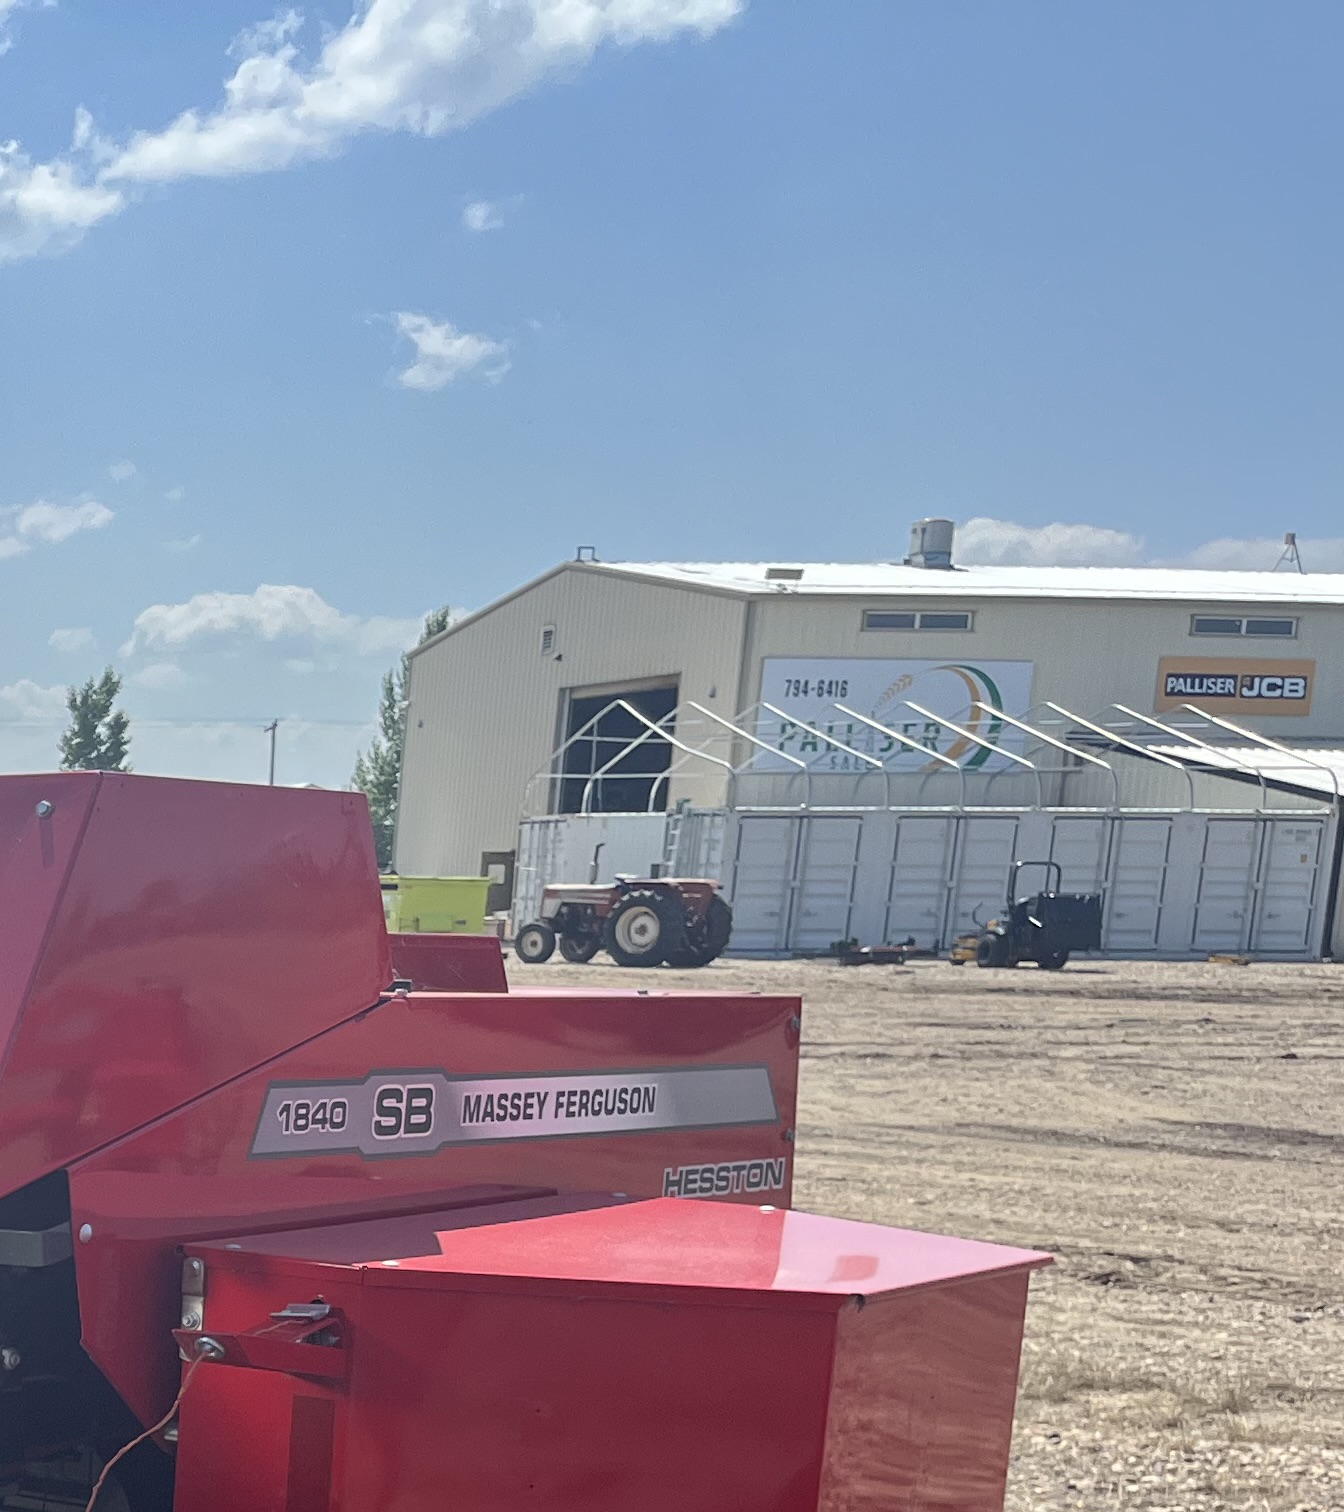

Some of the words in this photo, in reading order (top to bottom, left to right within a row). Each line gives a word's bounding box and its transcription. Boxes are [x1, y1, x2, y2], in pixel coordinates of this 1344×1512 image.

[784, 679, 849, 698] 794-6416
[1166, 676, 1235, 694] PALLISER
[1241, 677, 1306, 698] JCB
[278, 1099, 348, 1133] 1840
[374, 1086, 434, 1138] SB
[461, 1090, 550, 1125] MASSEY
[554, 1085, 657, 1120] FERGUSON
[663, 1160, 784, 1198] HESSTON
